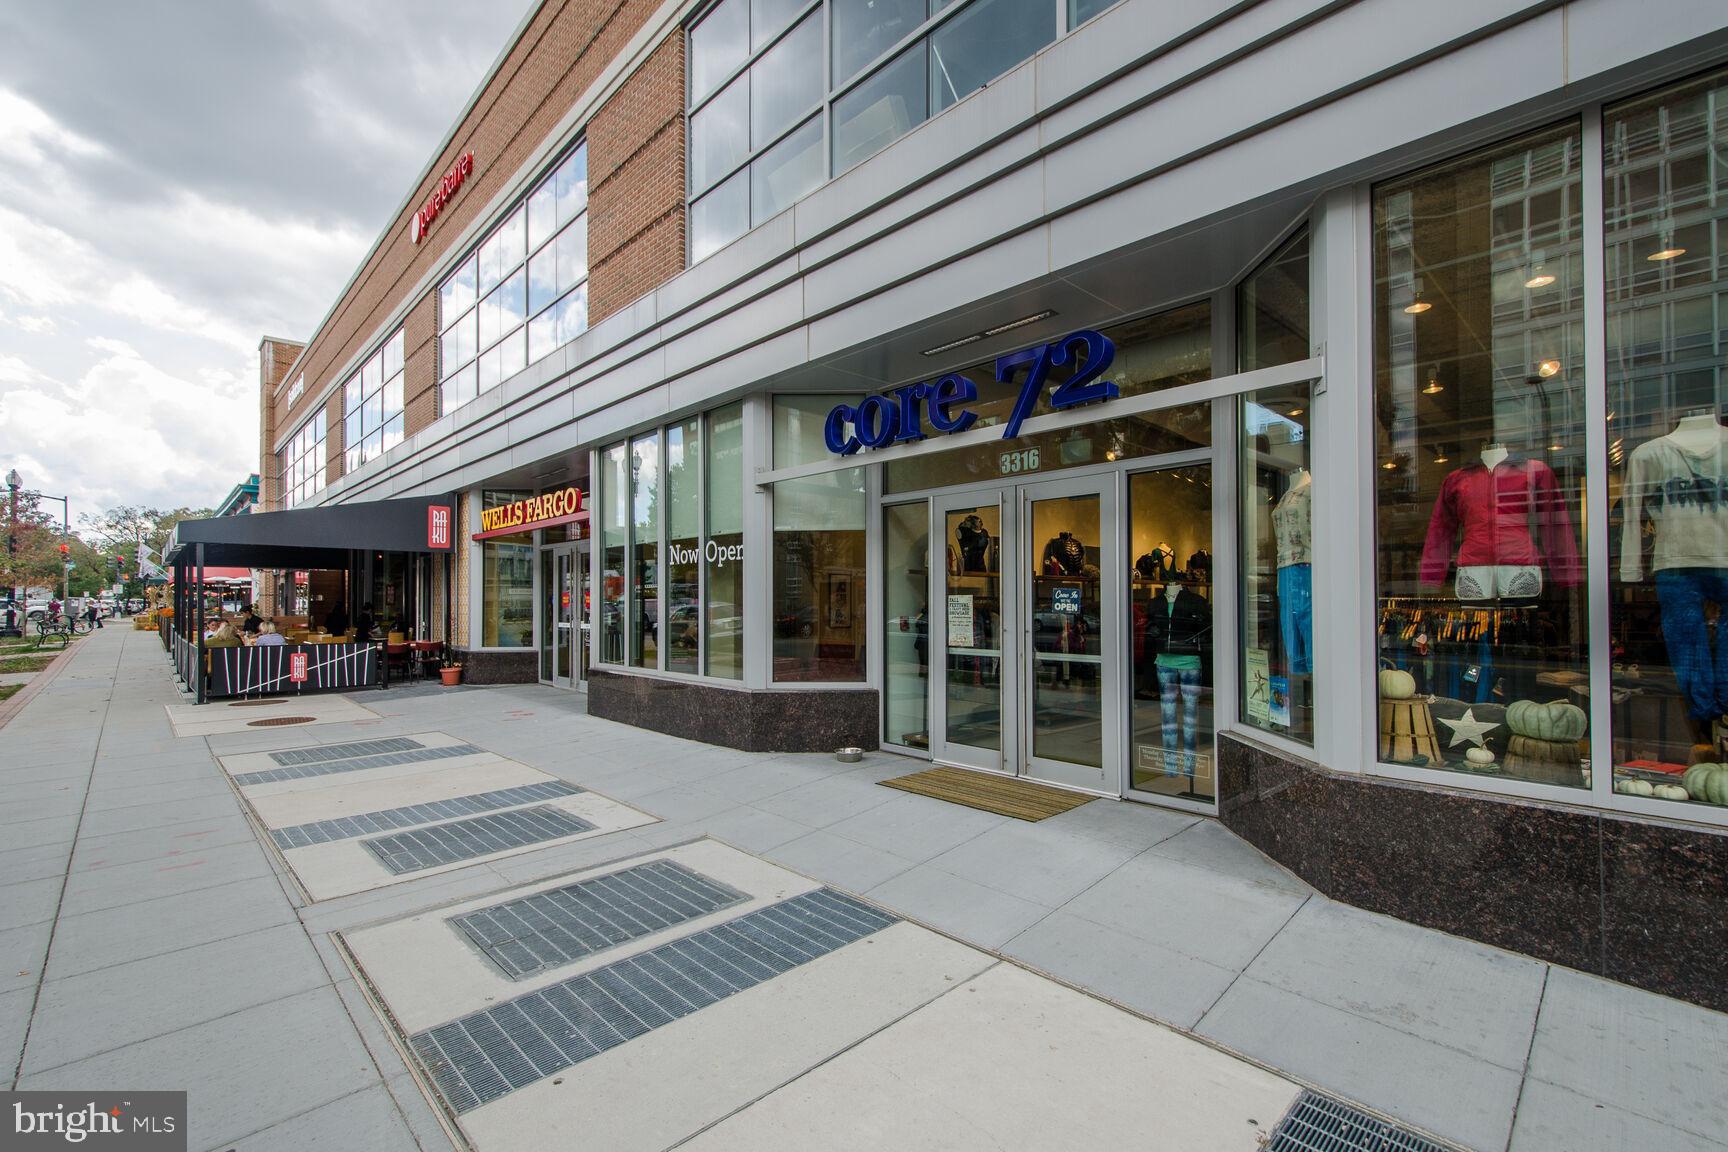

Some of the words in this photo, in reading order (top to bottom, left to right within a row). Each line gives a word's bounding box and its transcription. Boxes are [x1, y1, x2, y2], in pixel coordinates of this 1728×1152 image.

[824, 373, 978, 455] core
[996, 329, 1119, 439] 72
[1001, 449, 1039, 474] 3316
[481, 501, 523, 532] WELLS
[525, 487, 580, 523] FARGO
[669, 544, 700, 565] Now
[705, 540, 744, 568] Open
[1054, 602, 1078, 612] OPEN
[1055, 589, 1070, 599] Come
[1070, 590, 1078, 599] In
